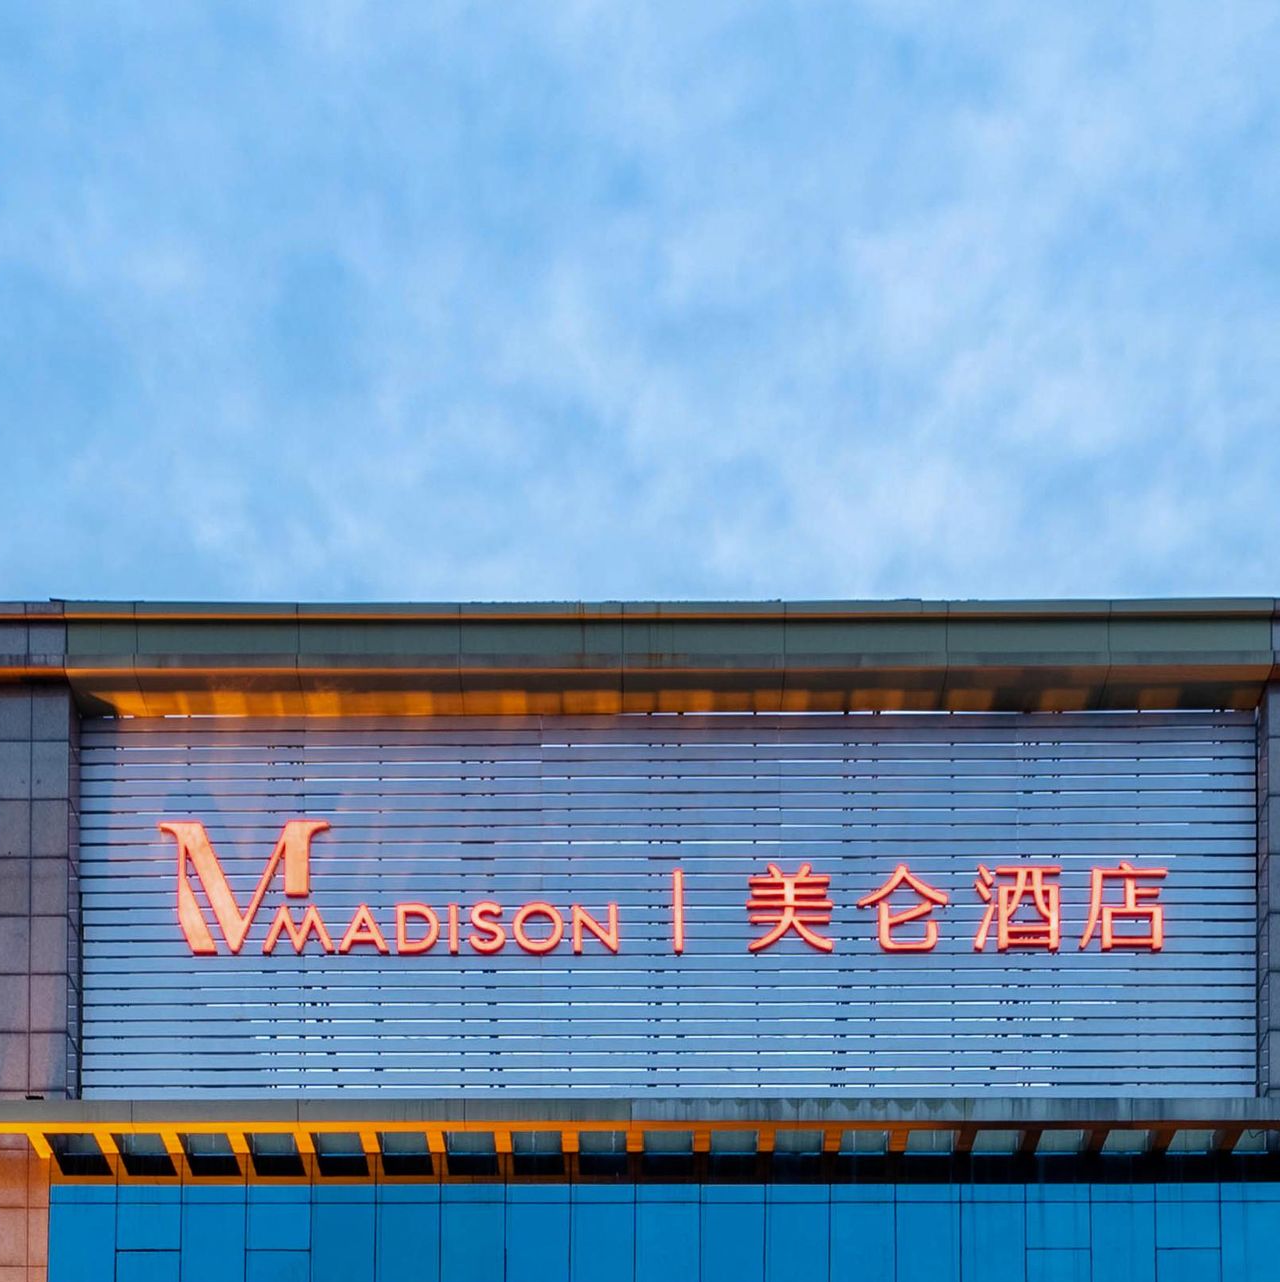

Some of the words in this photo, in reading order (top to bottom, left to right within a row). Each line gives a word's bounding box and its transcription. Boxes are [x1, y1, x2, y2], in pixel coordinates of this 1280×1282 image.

[262, 901, 620, 953] MADISON
[746, 861, 1167, 952] 美仑酒店
